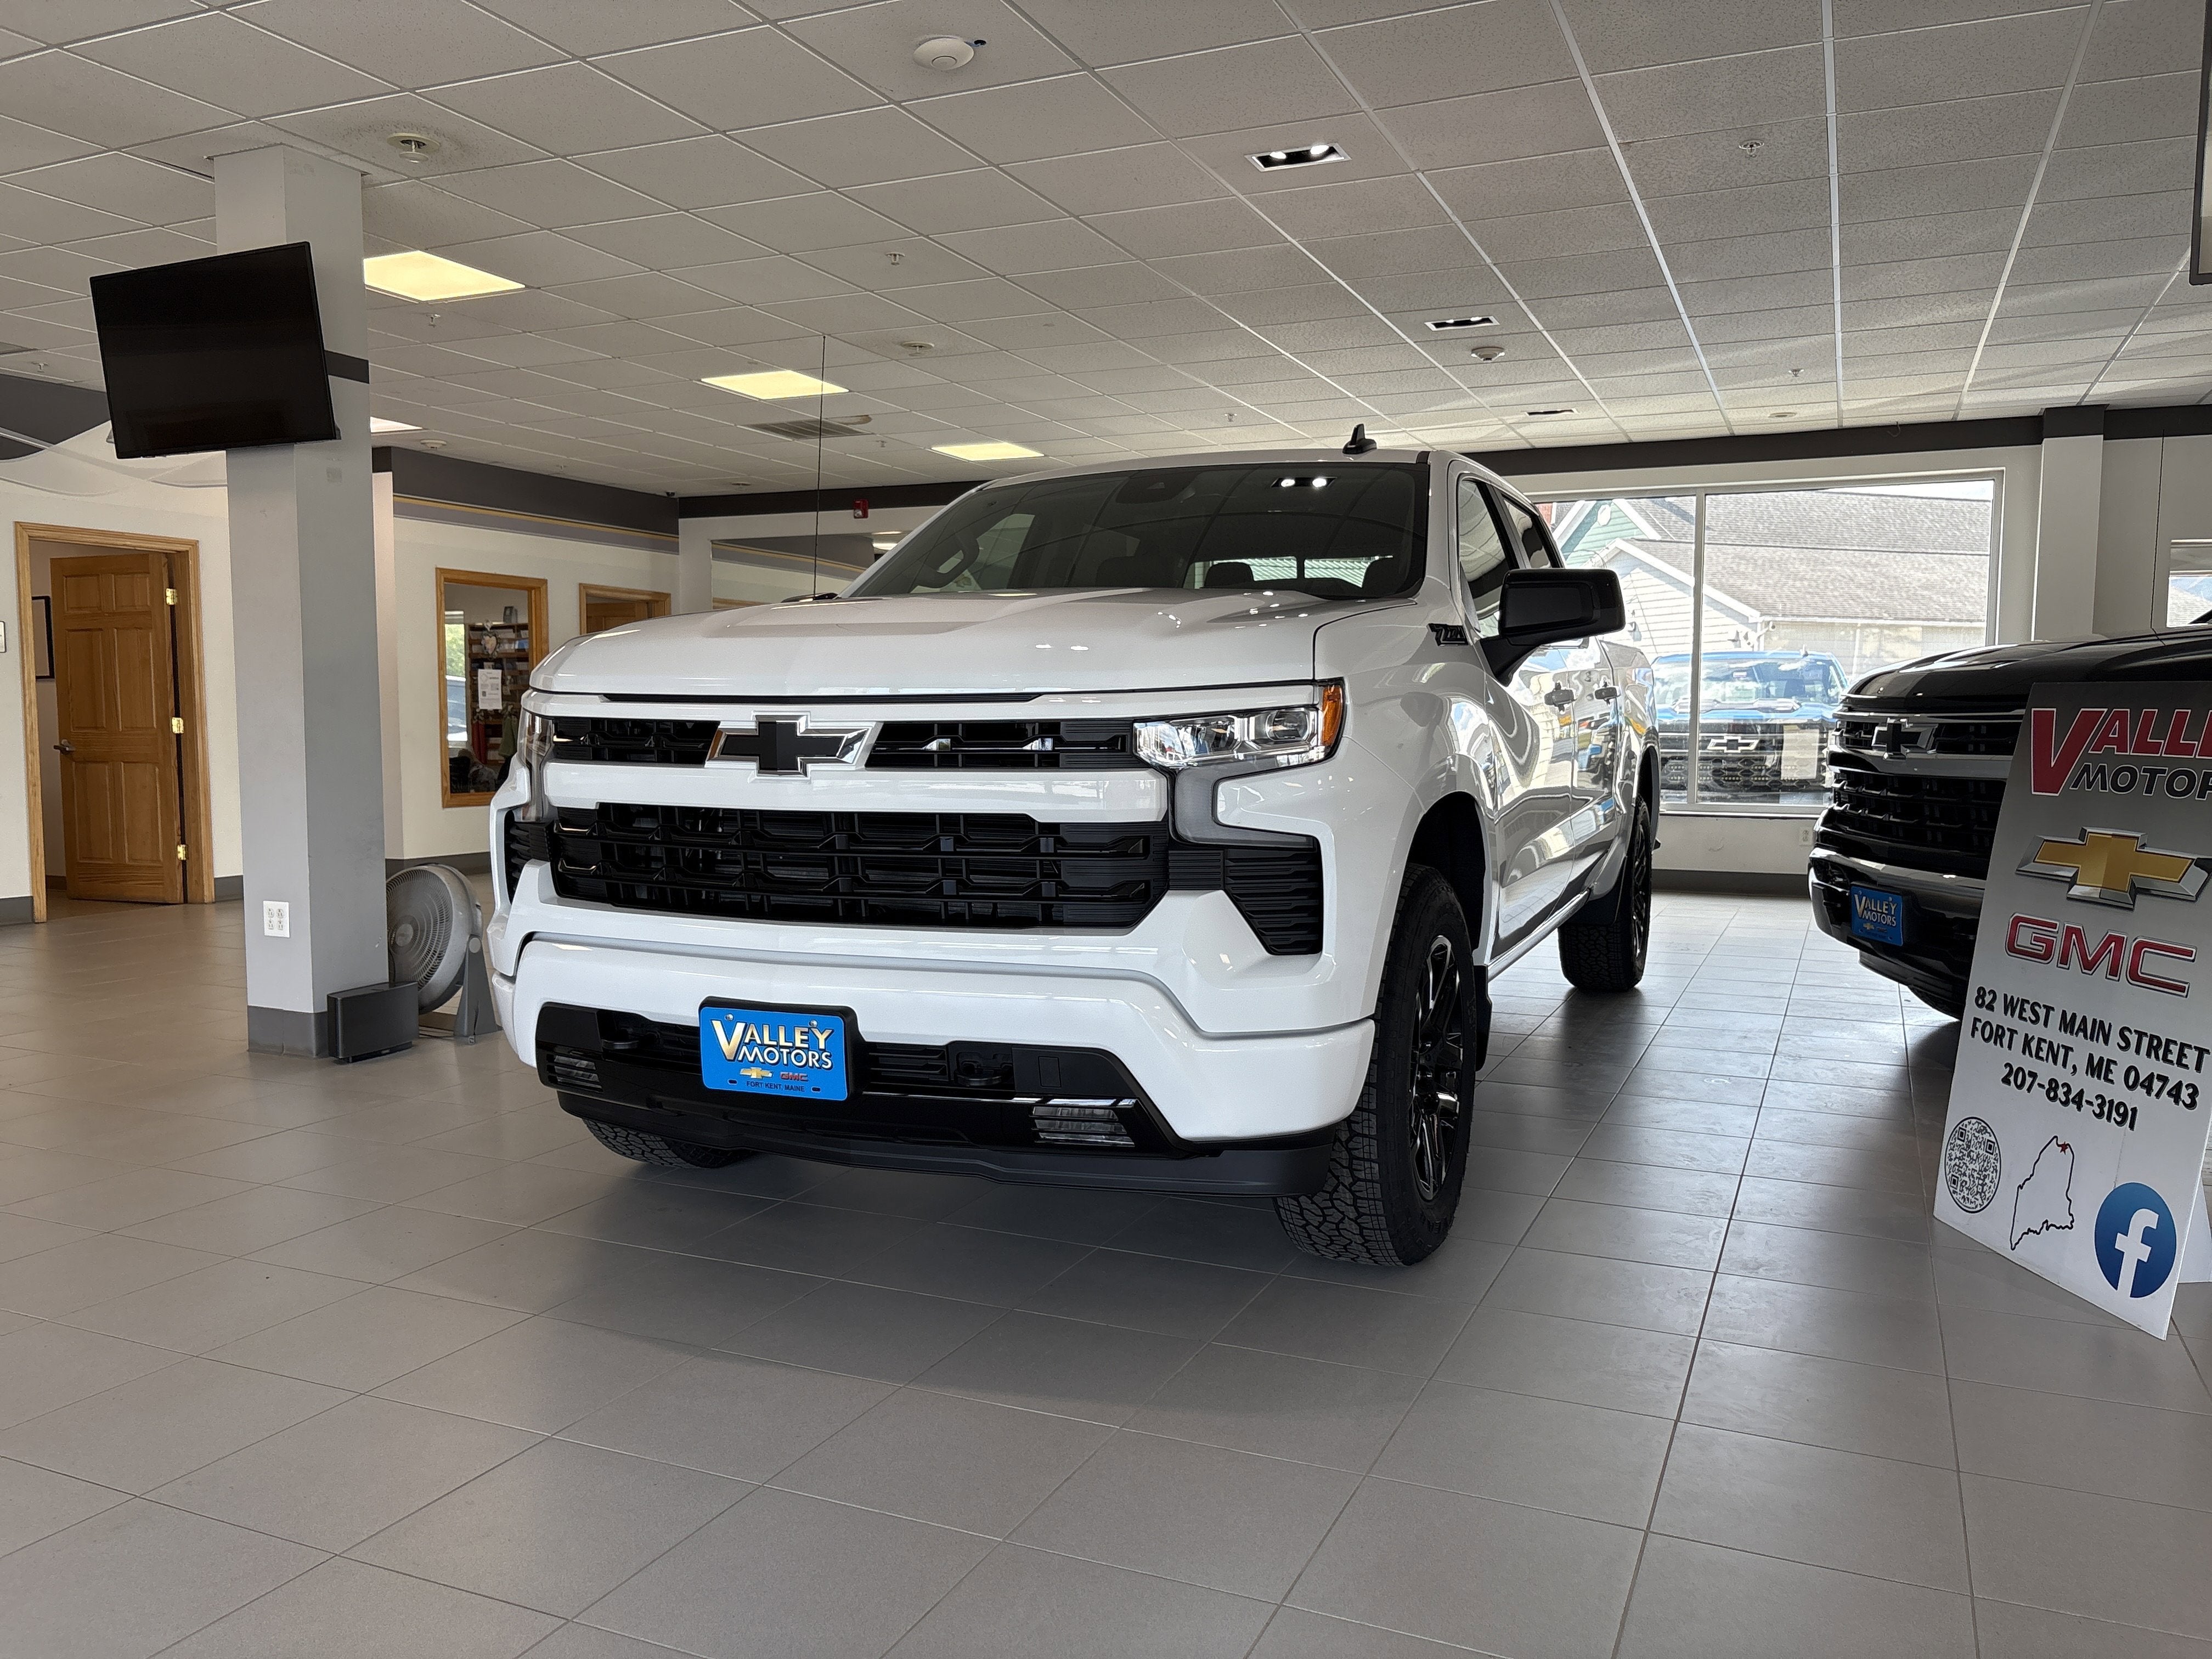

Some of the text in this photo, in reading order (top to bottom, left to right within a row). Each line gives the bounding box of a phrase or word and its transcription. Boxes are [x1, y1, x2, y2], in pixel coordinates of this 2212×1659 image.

[1854, 894, 1897, 918] VALLEY
[1863, 910, 1897, 927] MOTORS
[2005, 912, 2196, 998] GMC
[710, 1020, 834, 1062] VALLEY
[1974, 986, 2211, 1073] 82 WEST MAIN STREET
[737, 1045, 833, 1069] MOTORS
[780, 1071, 809, 1082] GMC
[1970, 1017, 2199, 1110] FORT KENT, ME 04743
[2001, 1062, 2138, 1131] 207-834-3191
